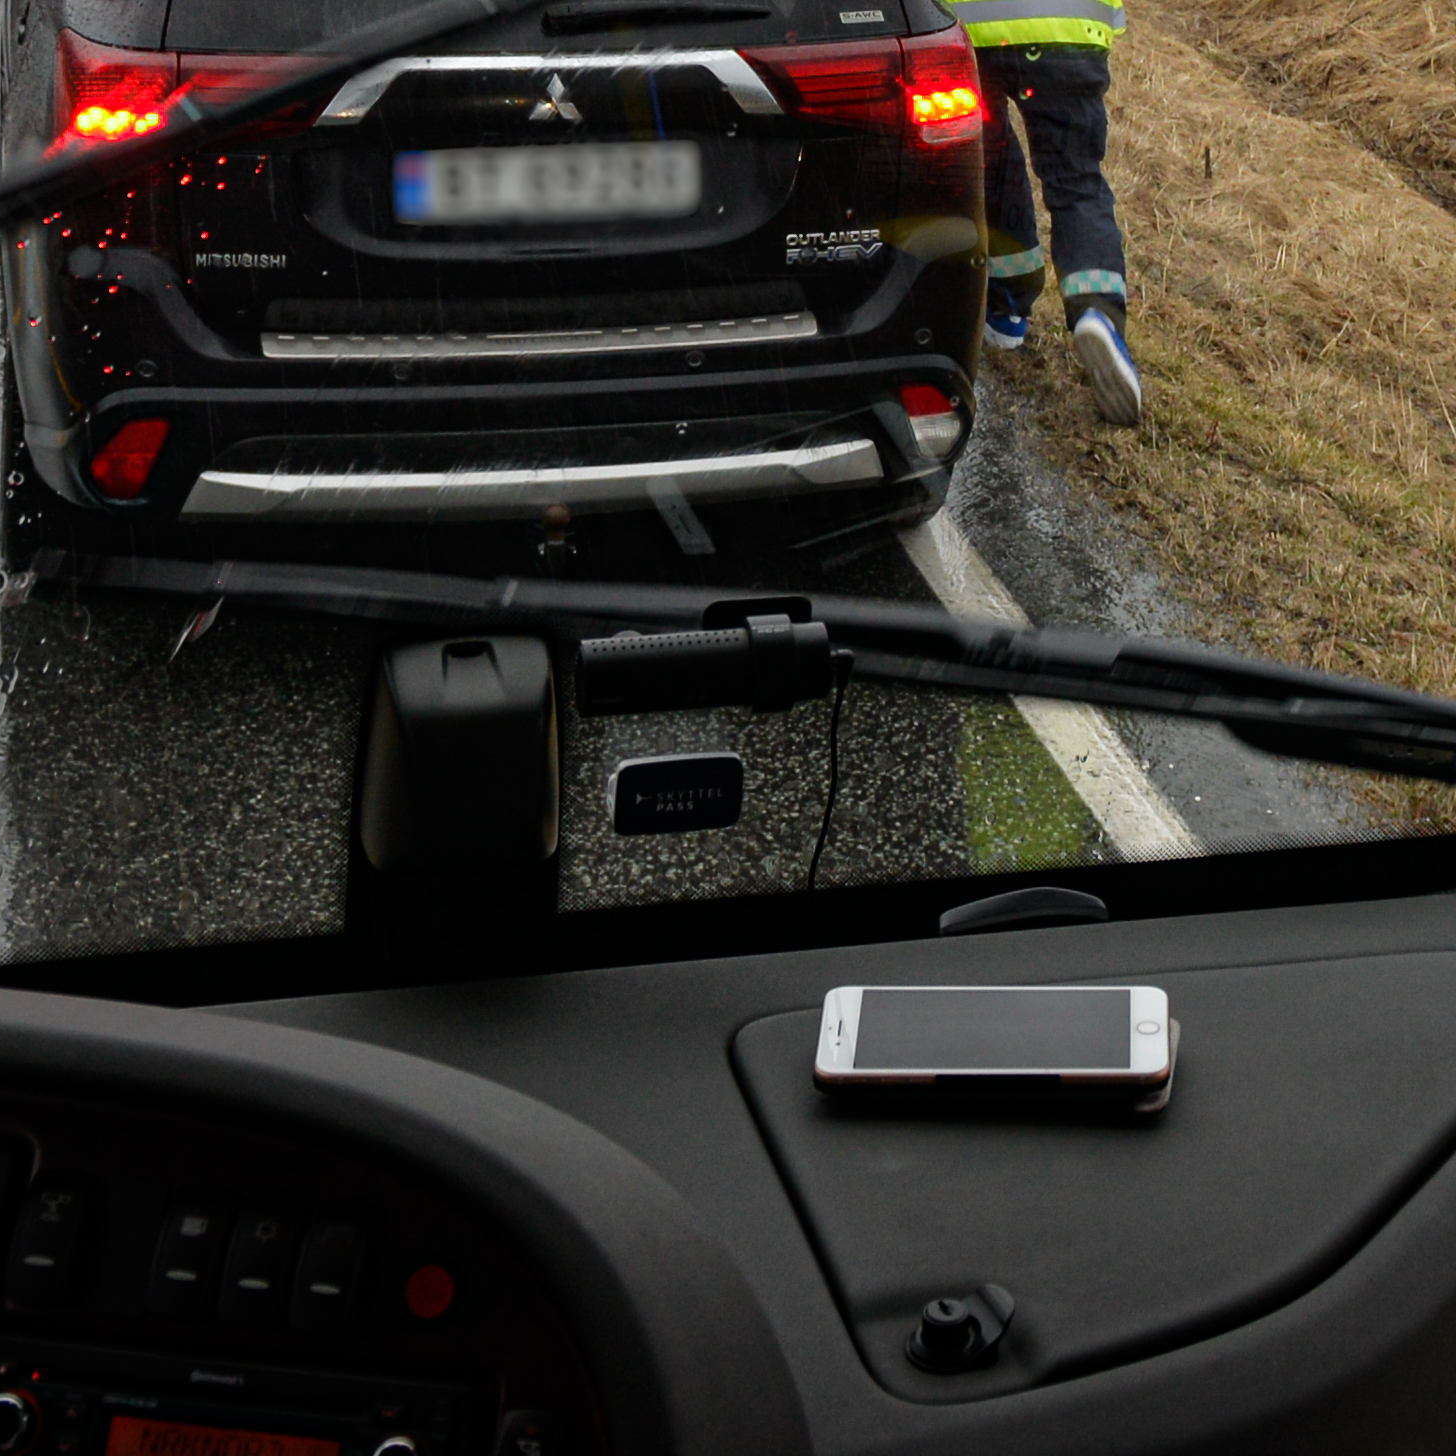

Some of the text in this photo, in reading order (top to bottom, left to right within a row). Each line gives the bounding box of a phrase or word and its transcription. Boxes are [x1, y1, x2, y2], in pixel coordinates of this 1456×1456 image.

[785, 228, 881, 246] OUTLANDER
[195, 252, 287, 269] MITSUBISHI
[656, 787, 724, 802] SKYTTEL
[655, 800, 694, 813] PASS
